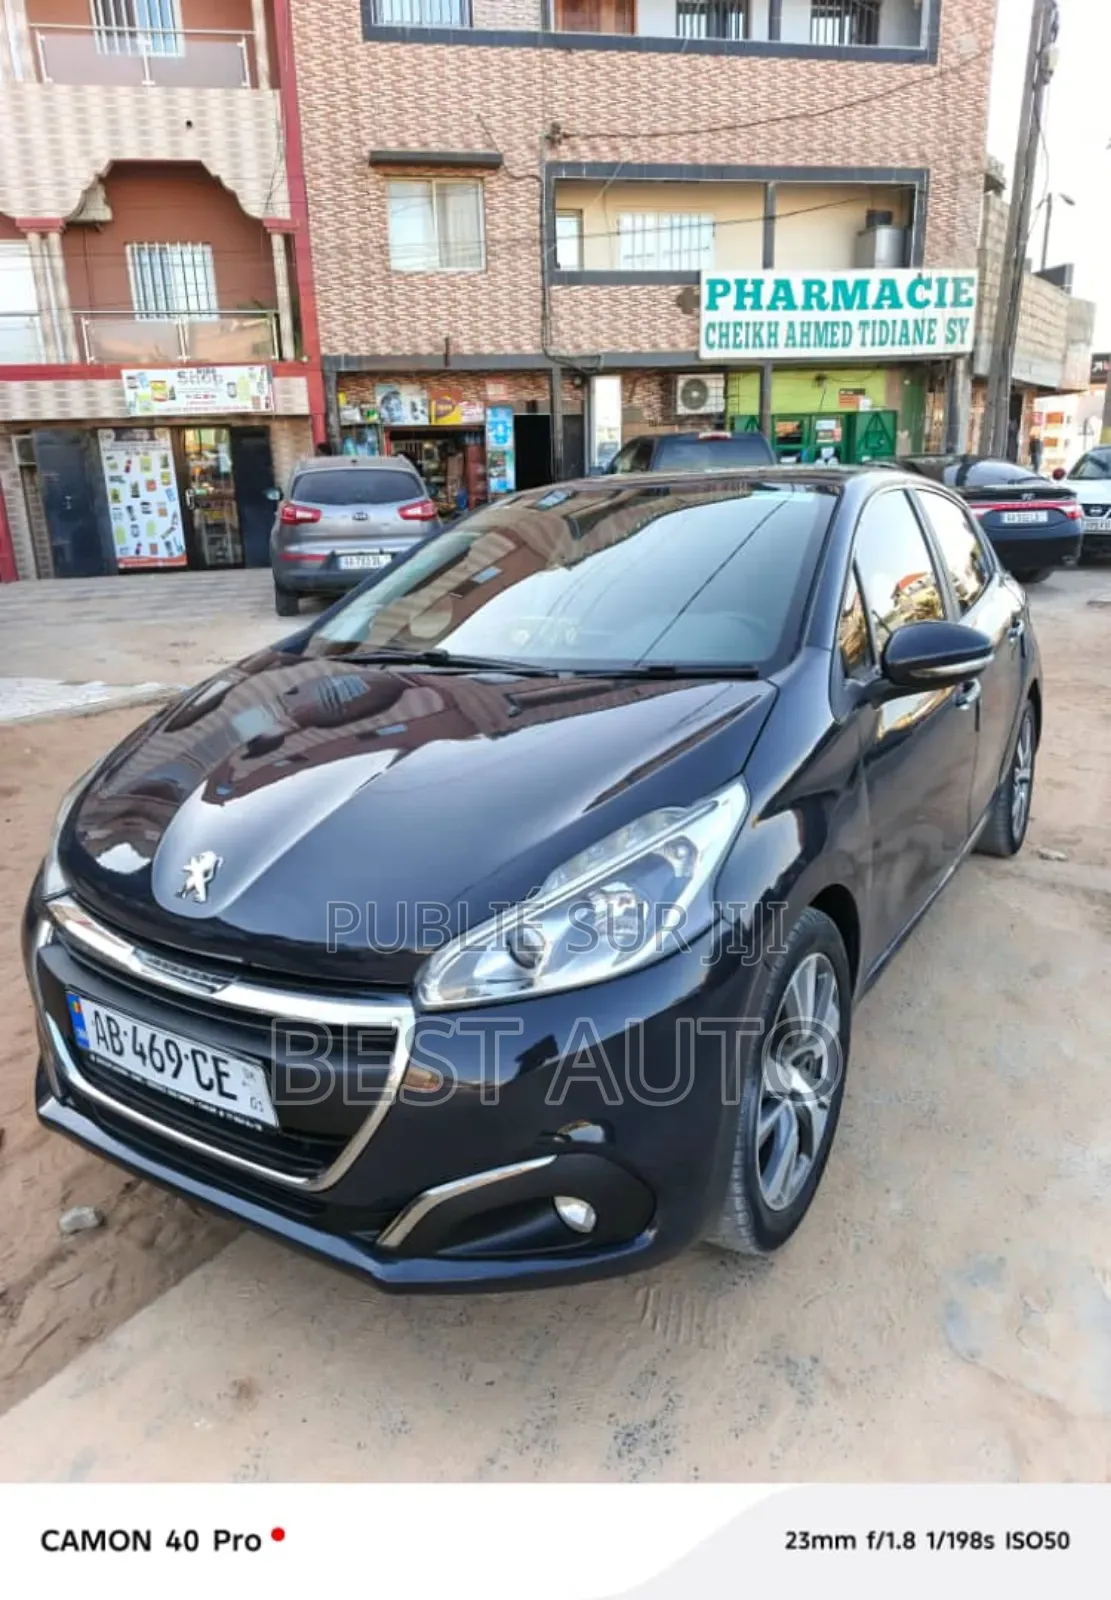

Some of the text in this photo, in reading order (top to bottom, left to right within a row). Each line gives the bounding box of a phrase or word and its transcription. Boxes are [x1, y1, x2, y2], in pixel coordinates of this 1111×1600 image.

[705, 276, 975, 311] PHARMACIE
[705, 317, 970, 350] CHEIKH AHMED TIDIANE SY
